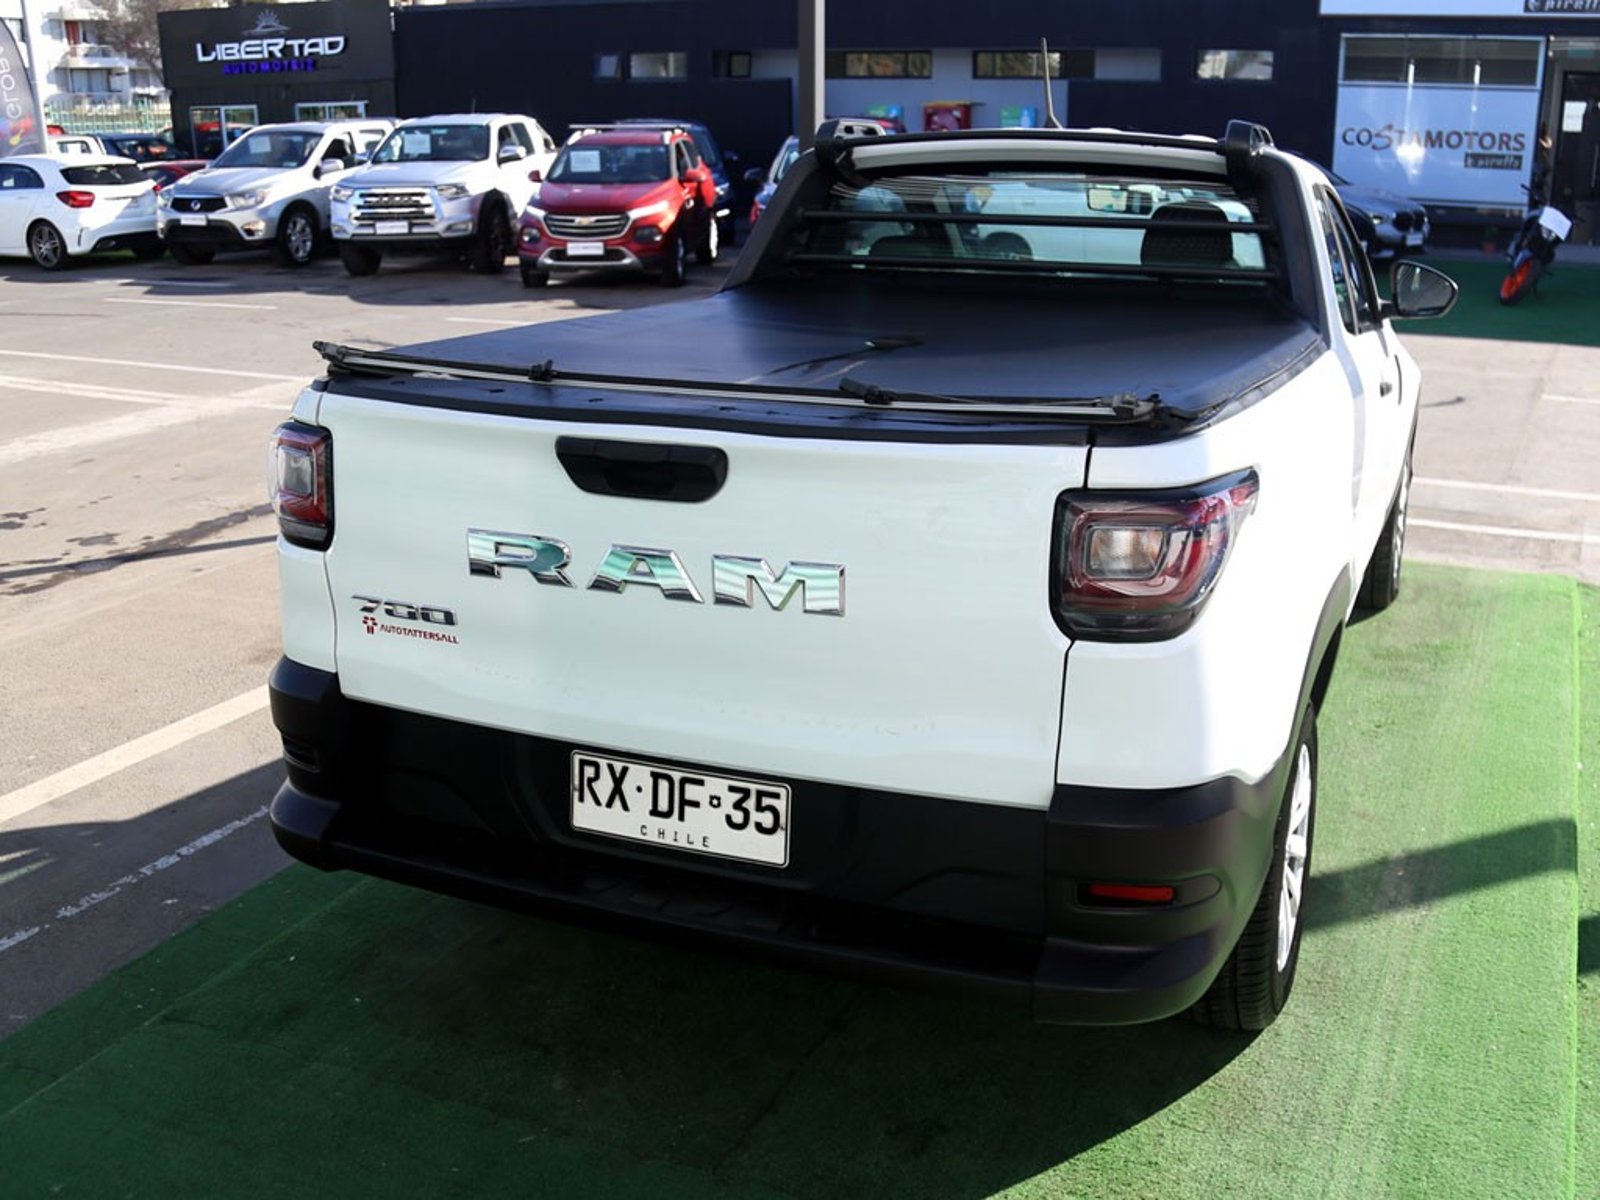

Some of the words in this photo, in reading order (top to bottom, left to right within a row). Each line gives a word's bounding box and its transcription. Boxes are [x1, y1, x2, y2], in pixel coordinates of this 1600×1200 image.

[196, 35, 345, 62] LIBERTAD
[223, 58, 316, 75] AUTOMOTRIZ
[466, 527, 846, 617] RAM
[351, 593, 458, 626] 700
[380, 623, 460, 645] AUTOTATTERSALL
[640, 824, 710, 848] CHILE
